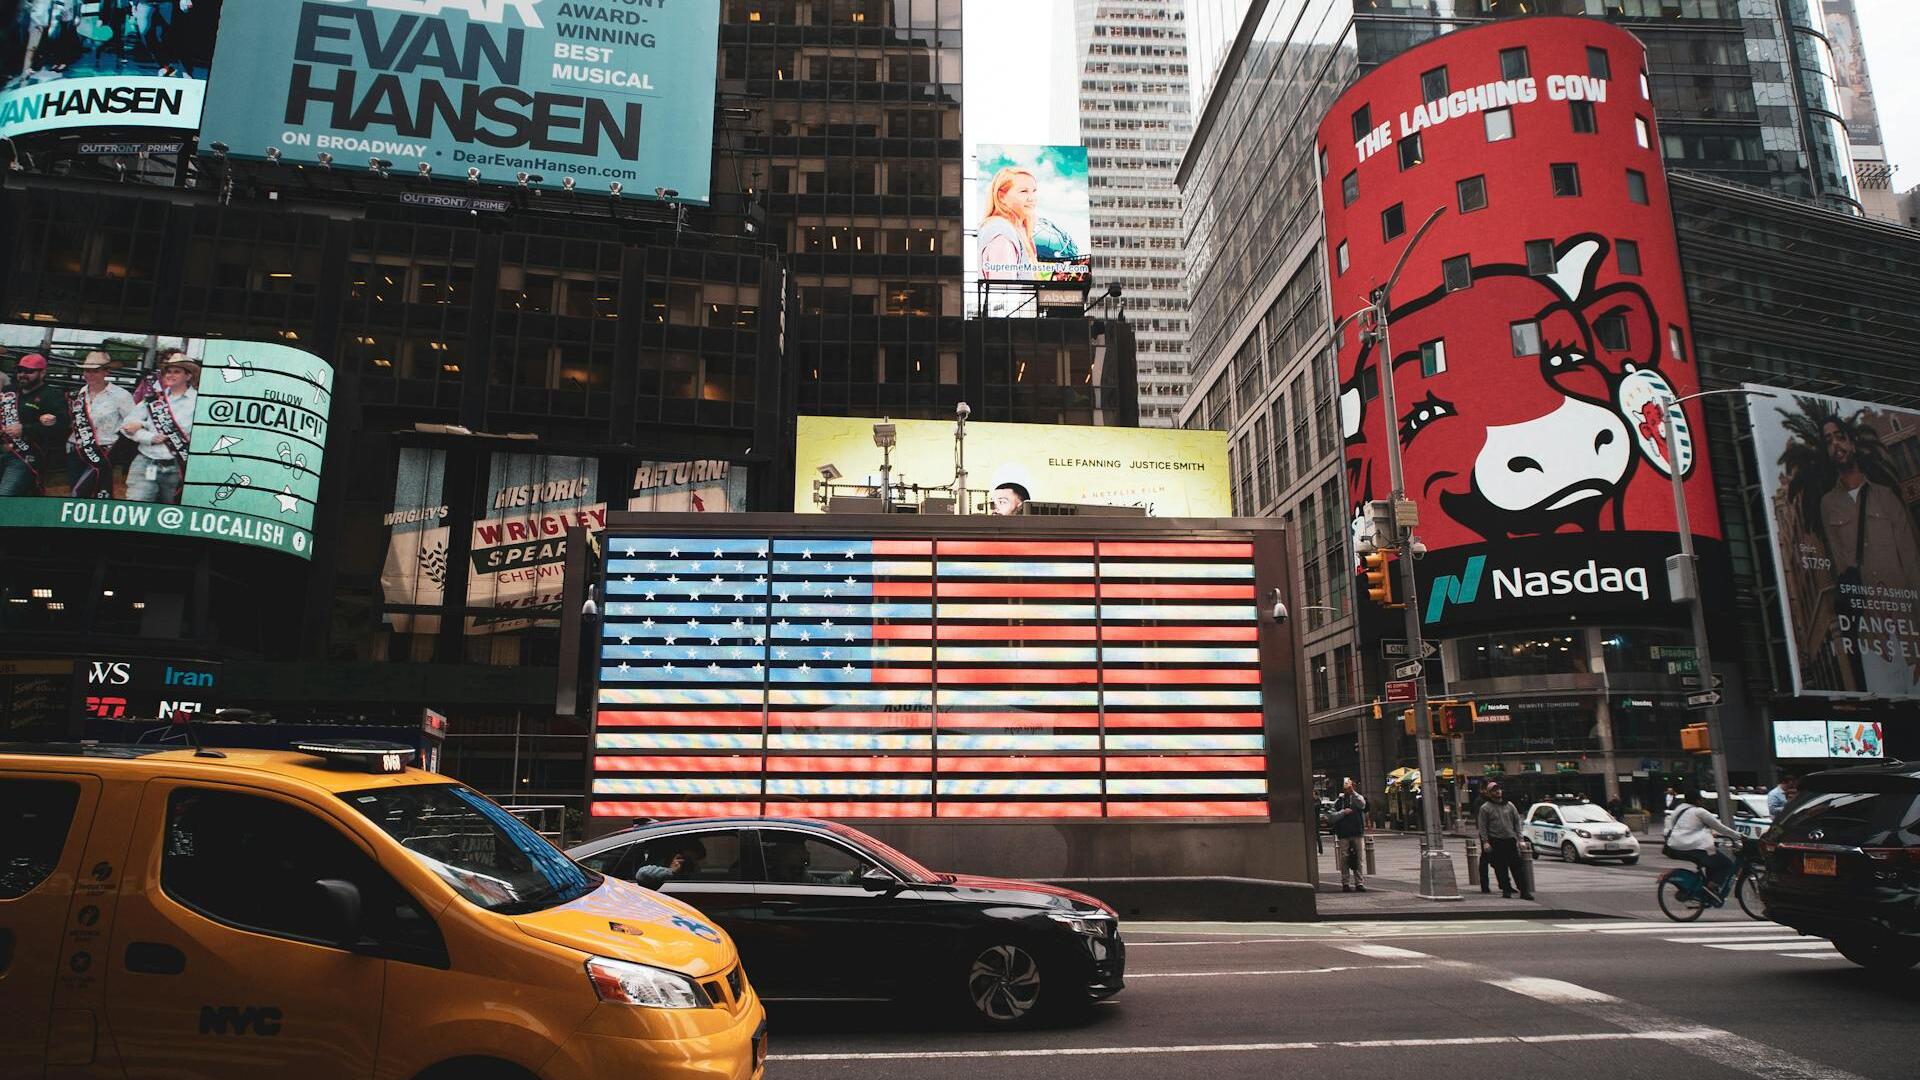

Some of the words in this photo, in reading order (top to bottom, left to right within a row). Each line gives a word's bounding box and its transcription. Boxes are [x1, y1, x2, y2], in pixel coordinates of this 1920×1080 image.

[557, 2, 649, 25] AWARD-
[294, 2, 525, 86] EVAN
[556, 22, 656, 49] WINNING
[554, 42, 613, 64] BEST
[552, 62, 654, 91] MUSICAL
[41, 87, 183, 119] HANSEN
[284, 63, 643, 162] HANSEN
[1355, 119, 1393, 163] THE
[1400, 77, 1537, 138] LAUGHING
[1547, 74, 1607, 103] COW
[81, 144, 140, 152] OUTFRONT
[147, 144, 178, 152] PRIME
[281, 131, 313, 148] ON
[316, 135, 427, 159] BROADWAY
[453, 149, 637, 180] DearEvanHansen.com
[403, 193, 466, 207] OUTFRONT
[473, 201, 505, 211] PRIME
[984, 261, 1089, 274] SupremeMasterTV.com
[264, 389, 303, 406] FOLLOW
[633, 460, 728, 491] RETURN!
[1048, 458, 1073, 467] ELLE
[1075, 459, 1121, 468] FANNING
[1129, 461, 1171, 470] JUSTICE
[1173, 462, 1205, 471] SMITH
[494, 477, 590, 510] HISTORIC
[1092, 489, 1136, 498] NETFLIX
[61, 503, 151, 527] FOLLOW
[190, 512, 284, 545] LOCALISH
[384, 505, 450, 527] WRIGLEY'S
[1802, 556, 1832, 571] $17.99
[1492, 560, 1650, 600] Nasdaq
[1840, 583, 1875, 598] SPRING
[1876, 587, 1919, 600] FASHION
[1850, 599, 1899, 612] SELECTED
[1900, 603, 1912, 613] BY
[164, 665, 214, 687] Iran
[1543, 831, 1558, 843] NYPD
[199, 1006, 282, 1036] NYC
